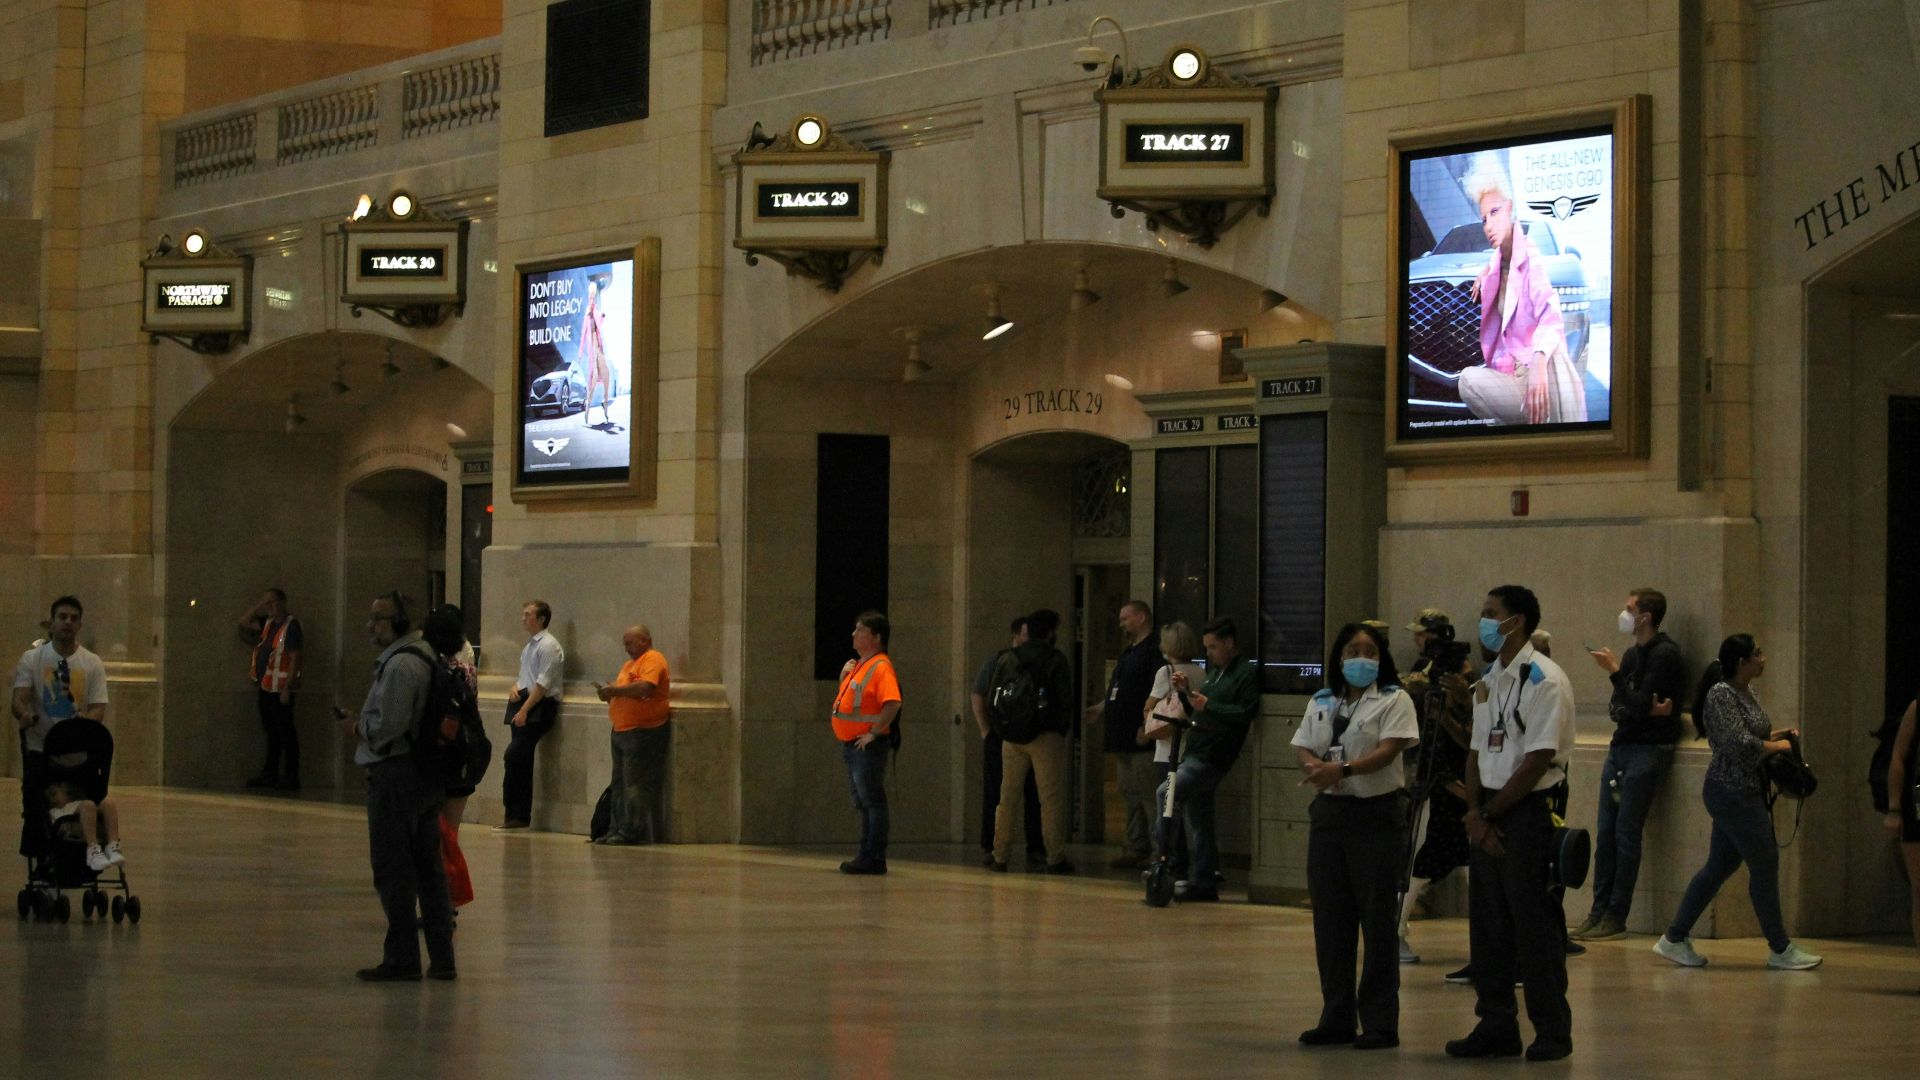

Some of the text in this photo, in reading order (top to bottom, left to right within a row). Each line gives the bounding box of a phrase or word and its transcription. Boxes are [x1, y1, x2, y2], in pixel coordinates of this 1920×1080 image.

[1140, 133, 1231, 151] TRACK 27
[1525, 147, 1603, 171] THE ALL-NEW
[1525, 169, 1603, 193] GENESIS G90
[771, 191, 849, 207] TRACK 29
[1793, 177, 1870, 251] THE
[371, 256, 436, 270] TRACK 30
[162, 284, 230, 296] NORTHWEST
[530, 278, 574, 300] DON'T BUY
[168, 294, 214, 306] PASSAGE
[530, 297, 583, 319] INTO LEGACY
[530, 325, 572, 346] BUILD ONE
[1270, 380, 1316, 395] TRACK 27
[1004, 388, 1103, 419] 29 TRACK 29
[1162, 420, 1201, 432] TRACK 29
[1223, 416, 1250, 429] TRACK
